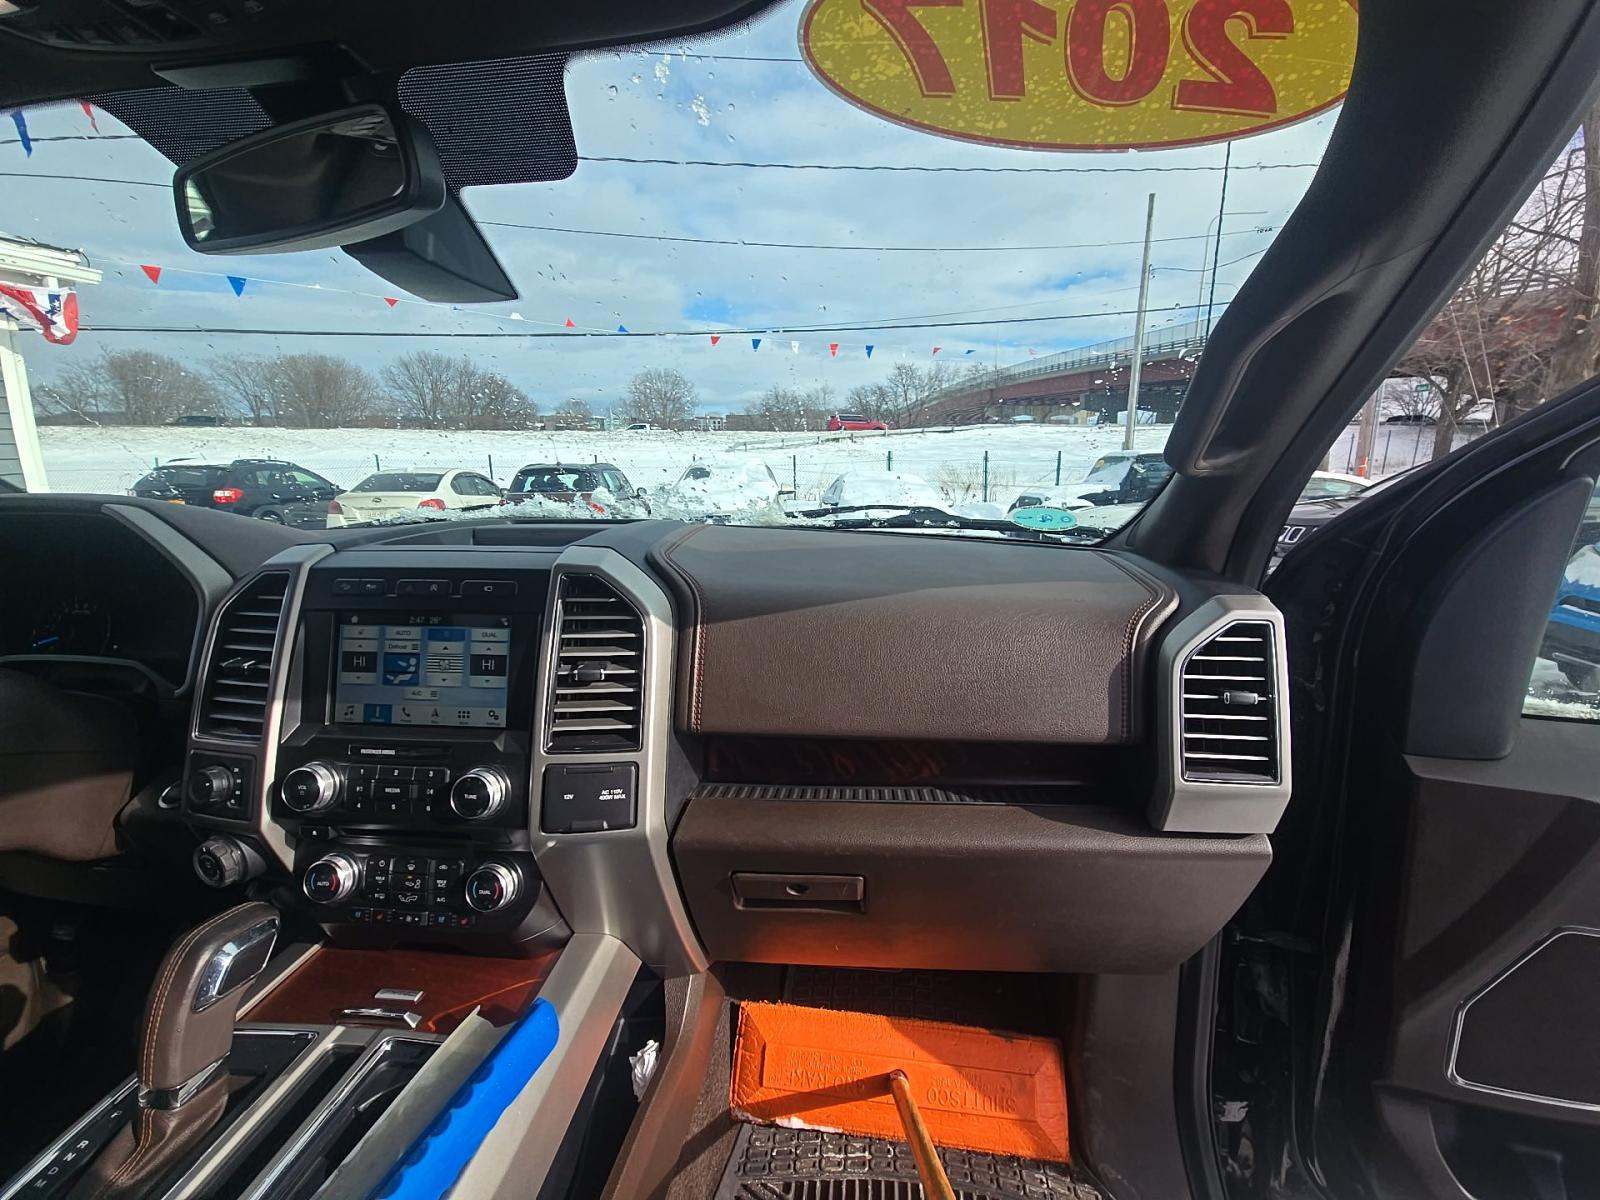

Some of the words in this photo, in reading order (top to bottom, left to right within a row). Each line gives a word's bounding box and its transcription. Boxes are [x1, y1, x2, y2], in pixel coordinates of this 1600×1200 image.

[353, 655, 366, 667] HI
[482, 658, 495, 671] HI
[76, 1140, 88, 1148] R
[63, 1152, 76, 1161] N
[48, 1166, 59, 1174] D
